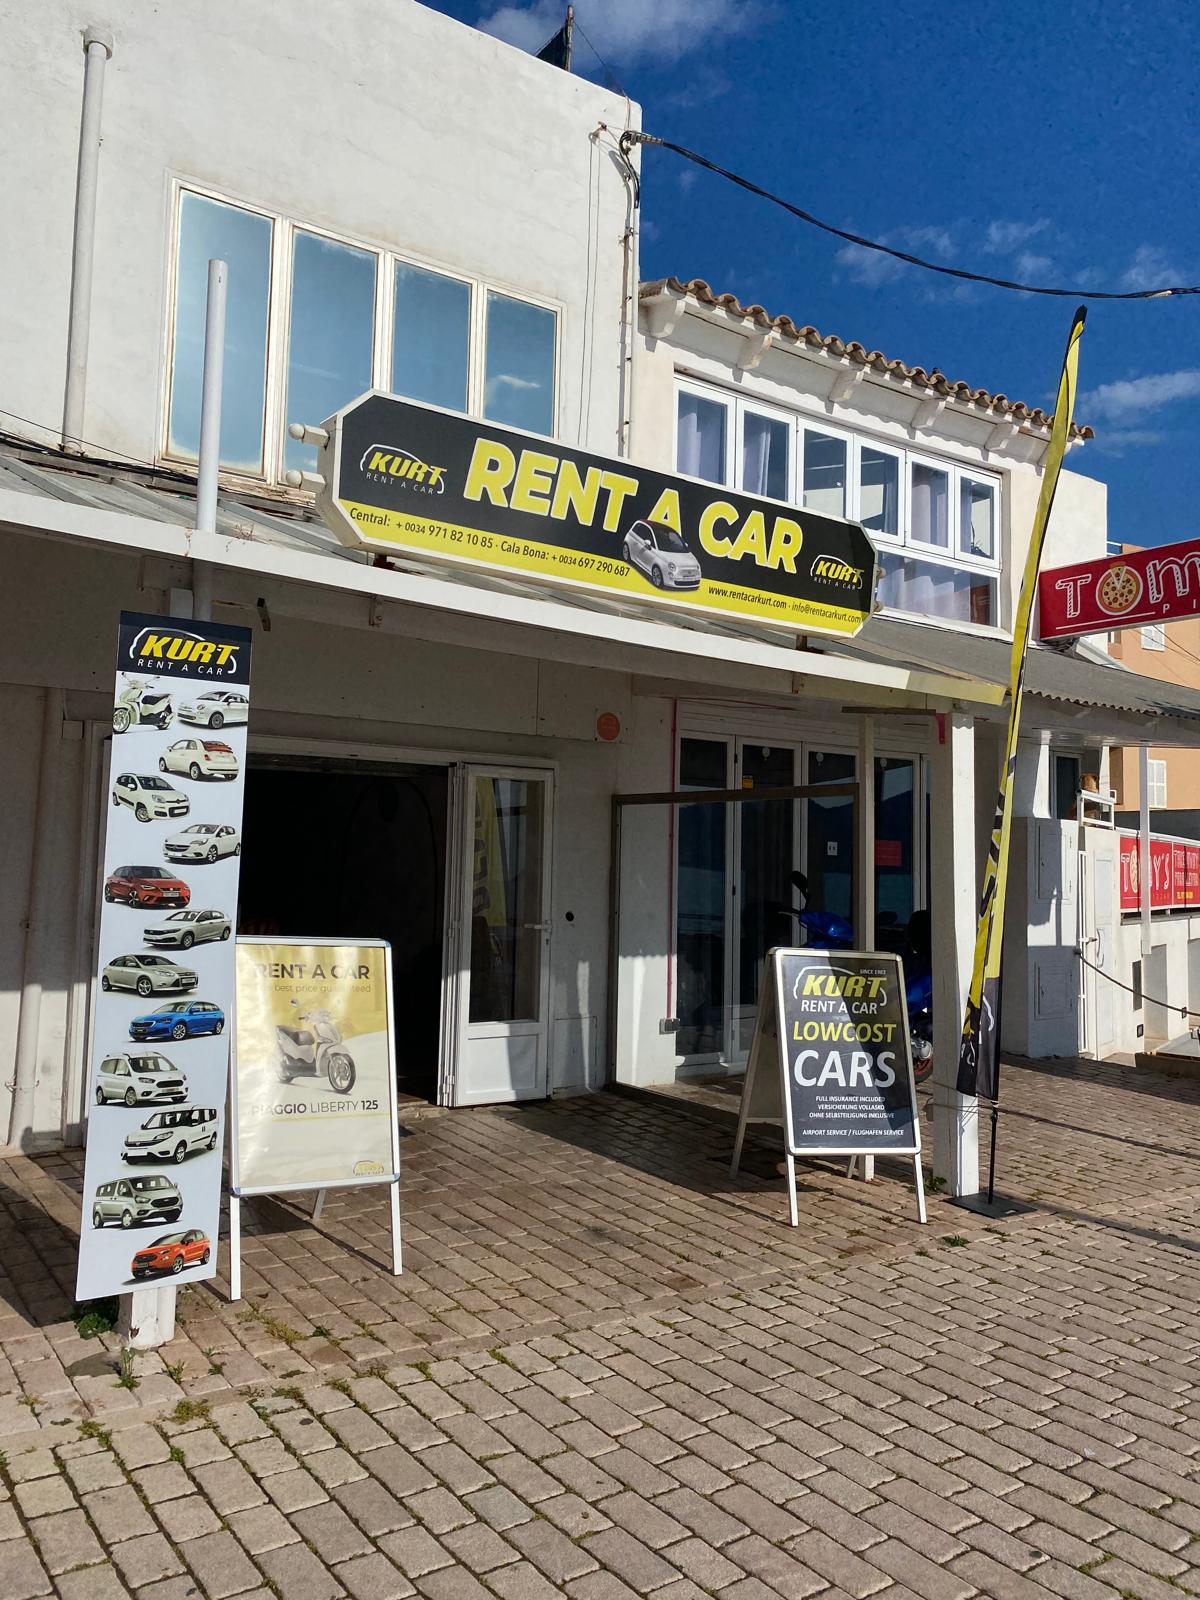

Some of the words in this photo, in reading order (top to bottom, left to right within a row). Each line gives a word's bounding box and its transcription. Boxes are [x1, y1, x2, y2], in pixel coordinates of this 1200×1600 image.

[368, 451, 447, 485] KURT
[366, 472, 394, 485] RENT
[400, 481, 407, 489] A
[413, 484, 434, 495] CAR
[463, 437, 639, 533] RENT
[647, 488, 683, 538] A
[699, 500, 804, 574] CAR
[350, 507, 391, 526] Central:
[405, 522, 426, 534] 0034
[428, 525, 448, 539] 971
[450, 530, 463, 543] 82
[466, 533, 479, 545] 10
[480, 536, 494, 549] 85
[500, 541, 520, 554] Cala
[522, 545, 549, 560] Bona:
[558, 554, 577, 566] 0034
[578, 557, 596, 569] 697
[596, 561, 613, 573] 290
[614, 565, 630, 577] 687
[814, 576, 831, 585] RENT
[842, 582, 856, 591] CAR
[815, 560, 864, 584] KURT
[708, 585, 787, 609] www.rentacarkurt.com
[792, 601, 862, 624] info@rentacarkurt.com
[140, 634, 240, 665] KURT
[137, 658, 174, 670] RENT
[181, 664, 189, 672] A
[197, 665, 222, 676] CAR
[254, 962, 307, 979] RENT
[311, 964, 326, 979] A
[331, 964, 370, 979] CAR
[274, 983, 293, 992] best
[296, 983, 318, 994] price
[802, 975, 887, 998] KURT
[801, 1000, 835, 1013] RENT
[839, 1003, 848, 1013] A
[852, 1002, 877, 1015] CAR
[793, 1021, 897, 1042] LOWCOST
[793, 1050, 896, 1087] CARS
[251, 1103, 307, 1116] PIAGGIO
[310, 1100, 359, 1113] LIBERTY
[361, 1099, 379, 1111] 125
